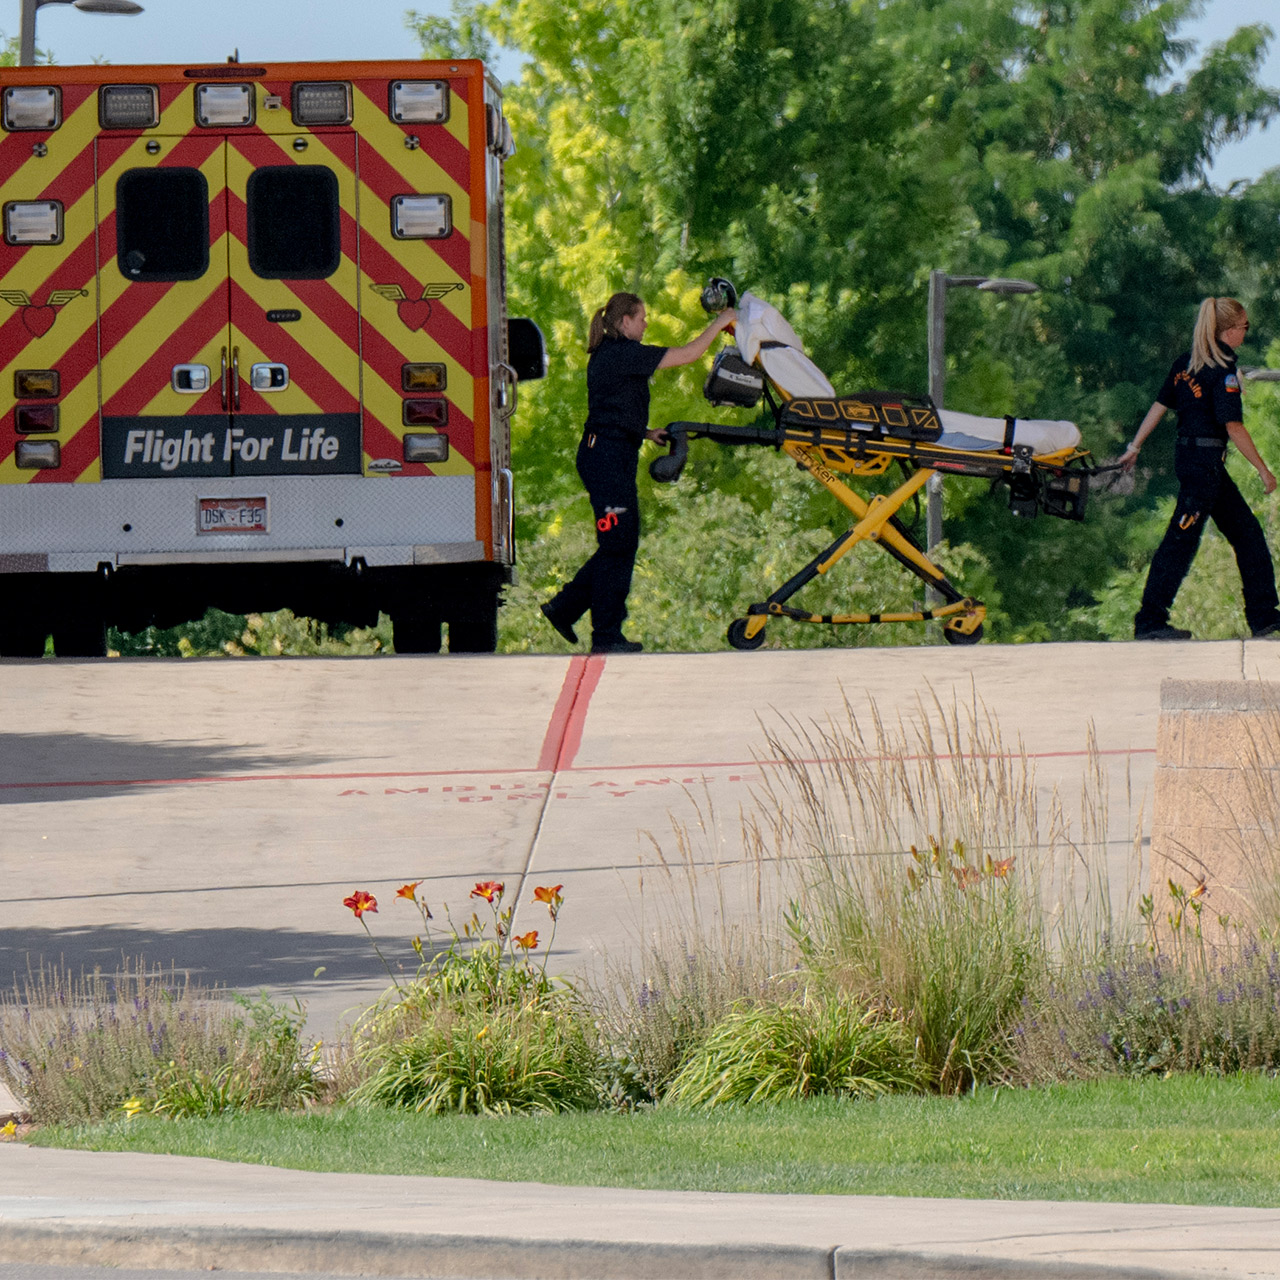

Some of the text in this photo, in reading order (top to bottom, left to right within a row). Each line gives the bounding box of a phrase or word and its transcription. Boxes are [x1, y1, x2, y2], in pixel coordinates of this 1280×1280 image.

[124, 427, 339, 470] Flight For Life
[793, 446, 836, 483] stryker
[205, 508, 262, 524] DSK F35
[337, 774, 759, 796] AMBULANCE
[458, 790, 636, 803] ONLY
